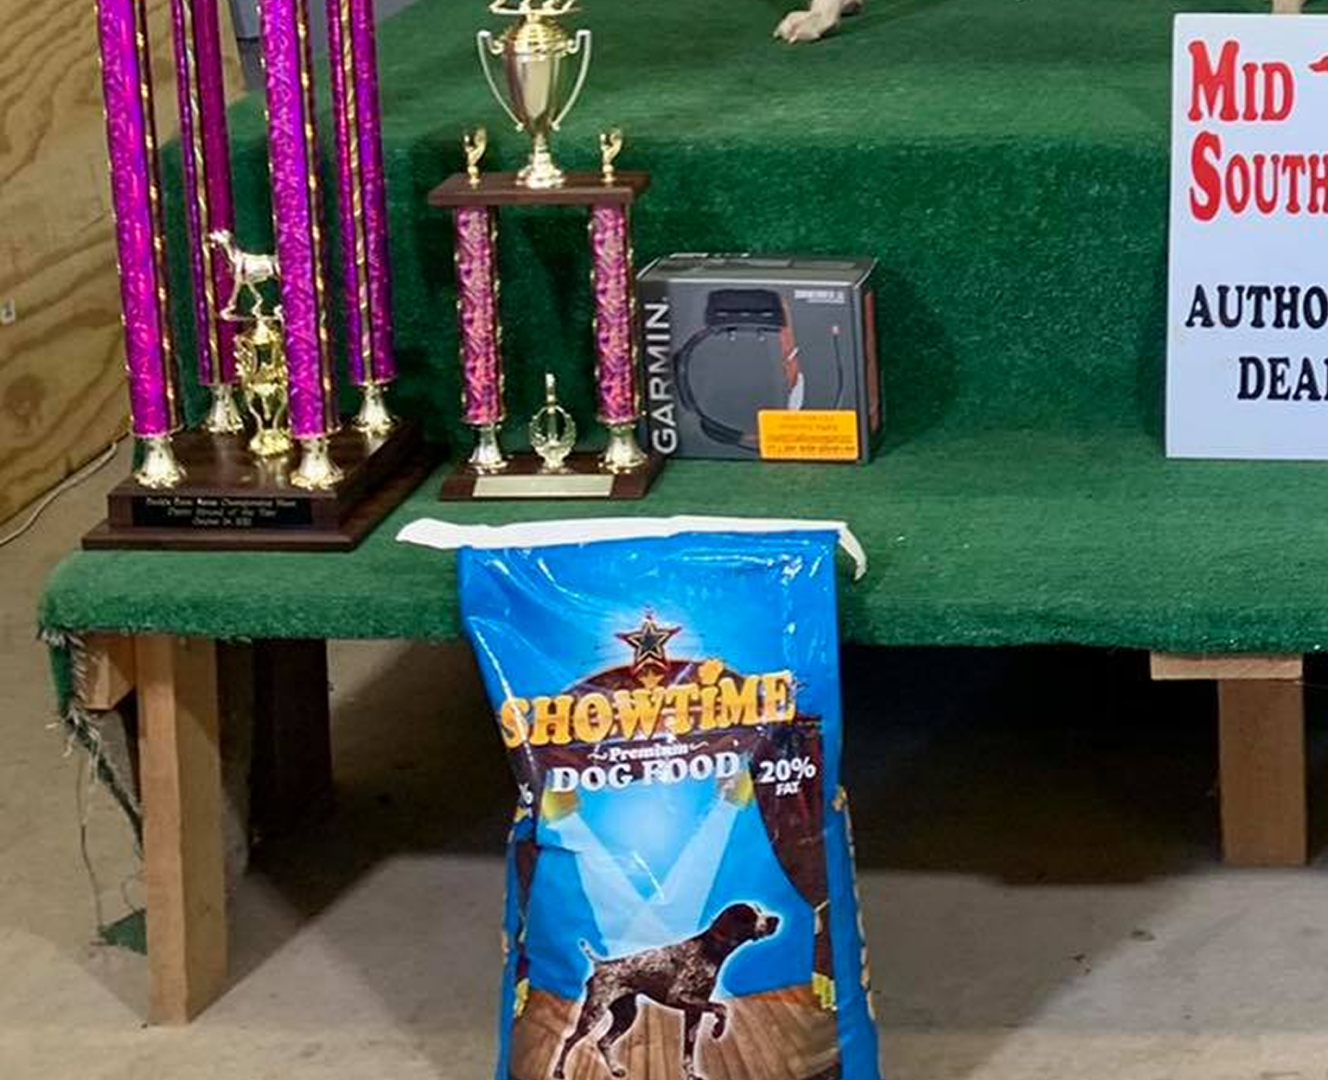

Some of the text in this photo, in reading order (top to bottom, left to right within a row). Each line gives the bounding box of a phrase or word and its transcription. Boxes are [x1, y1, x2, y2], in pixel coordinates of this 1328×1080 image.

[1187, 40, 1295, 122] MID
[645, 303, 678, 453] GARMIN
[608, 742, 689, 762] Premium
[552, 751, 741, 793] DOG FOOD
[758, 756, 817, 783] 20%
[775, 781, 801, 796] FAT
